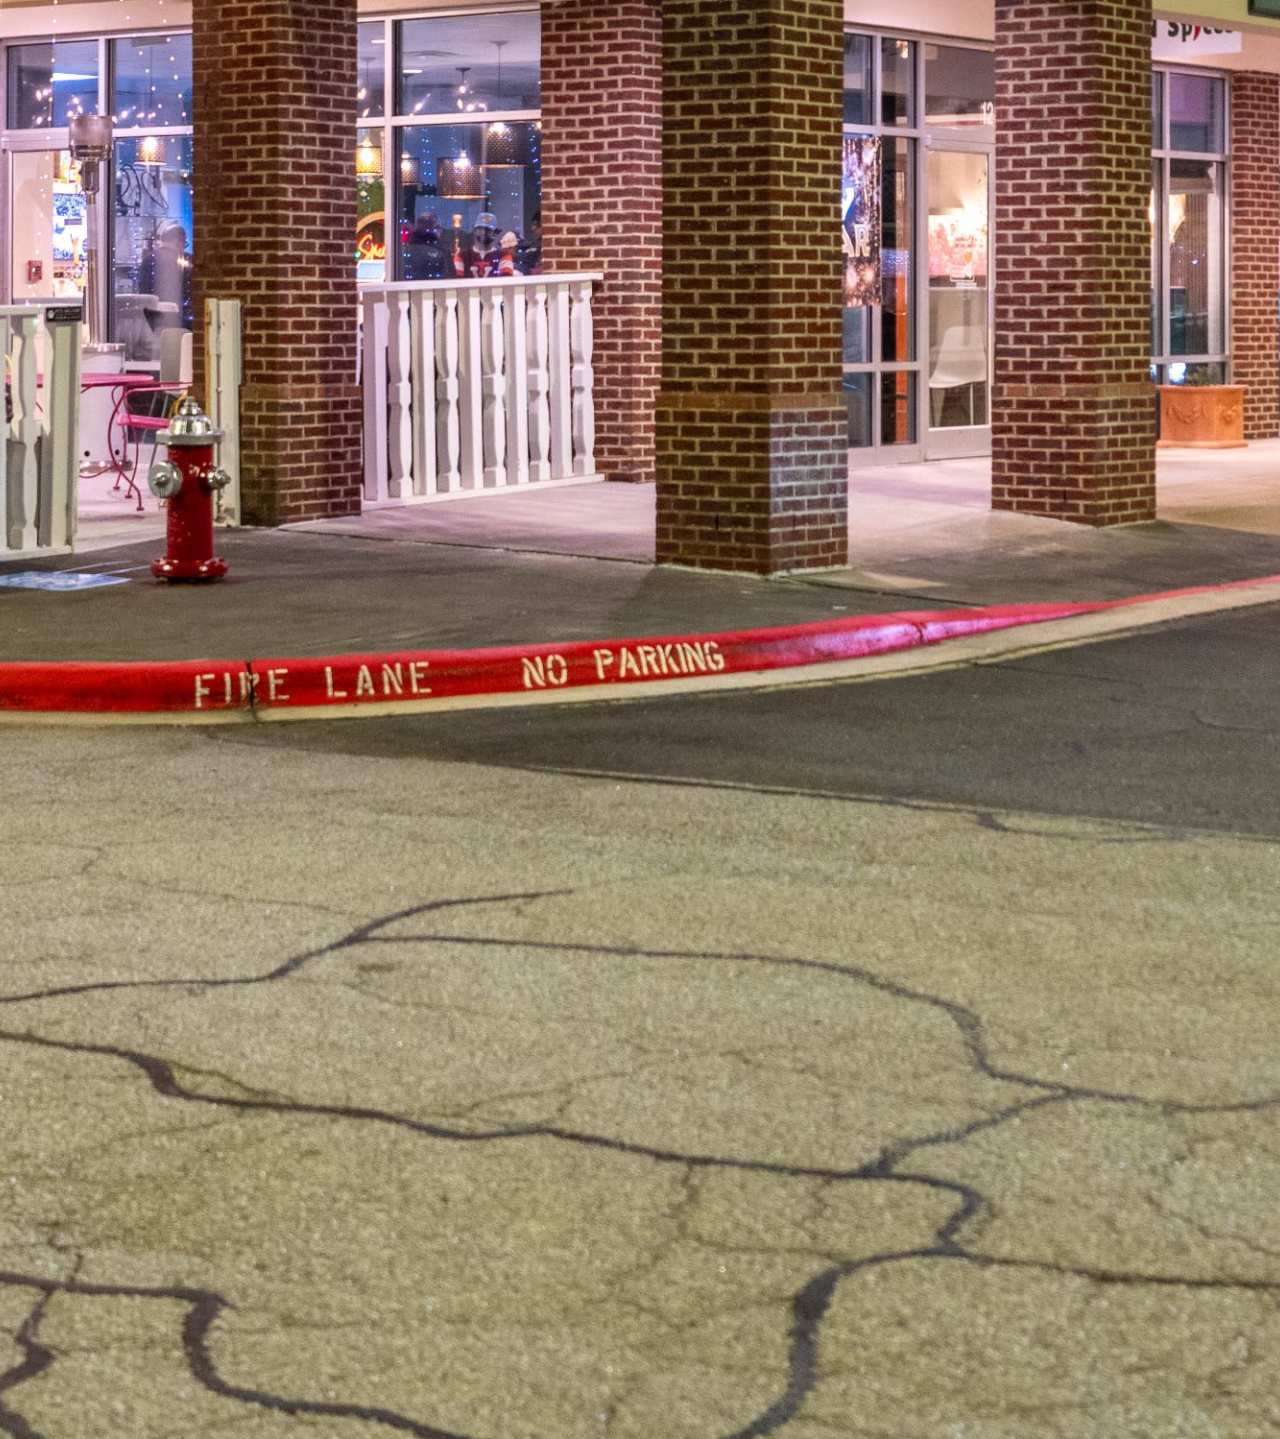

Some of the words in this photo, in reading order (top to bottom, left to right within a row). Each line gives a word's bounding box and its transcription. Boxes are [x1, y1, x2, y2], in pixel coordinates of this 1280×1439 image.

[195, 669, 290, 708] FIRE
[325, 661, 432, 698] LANE
[521, 654, 568, 688] NO
[593, 641, 725, 679] PARKING
